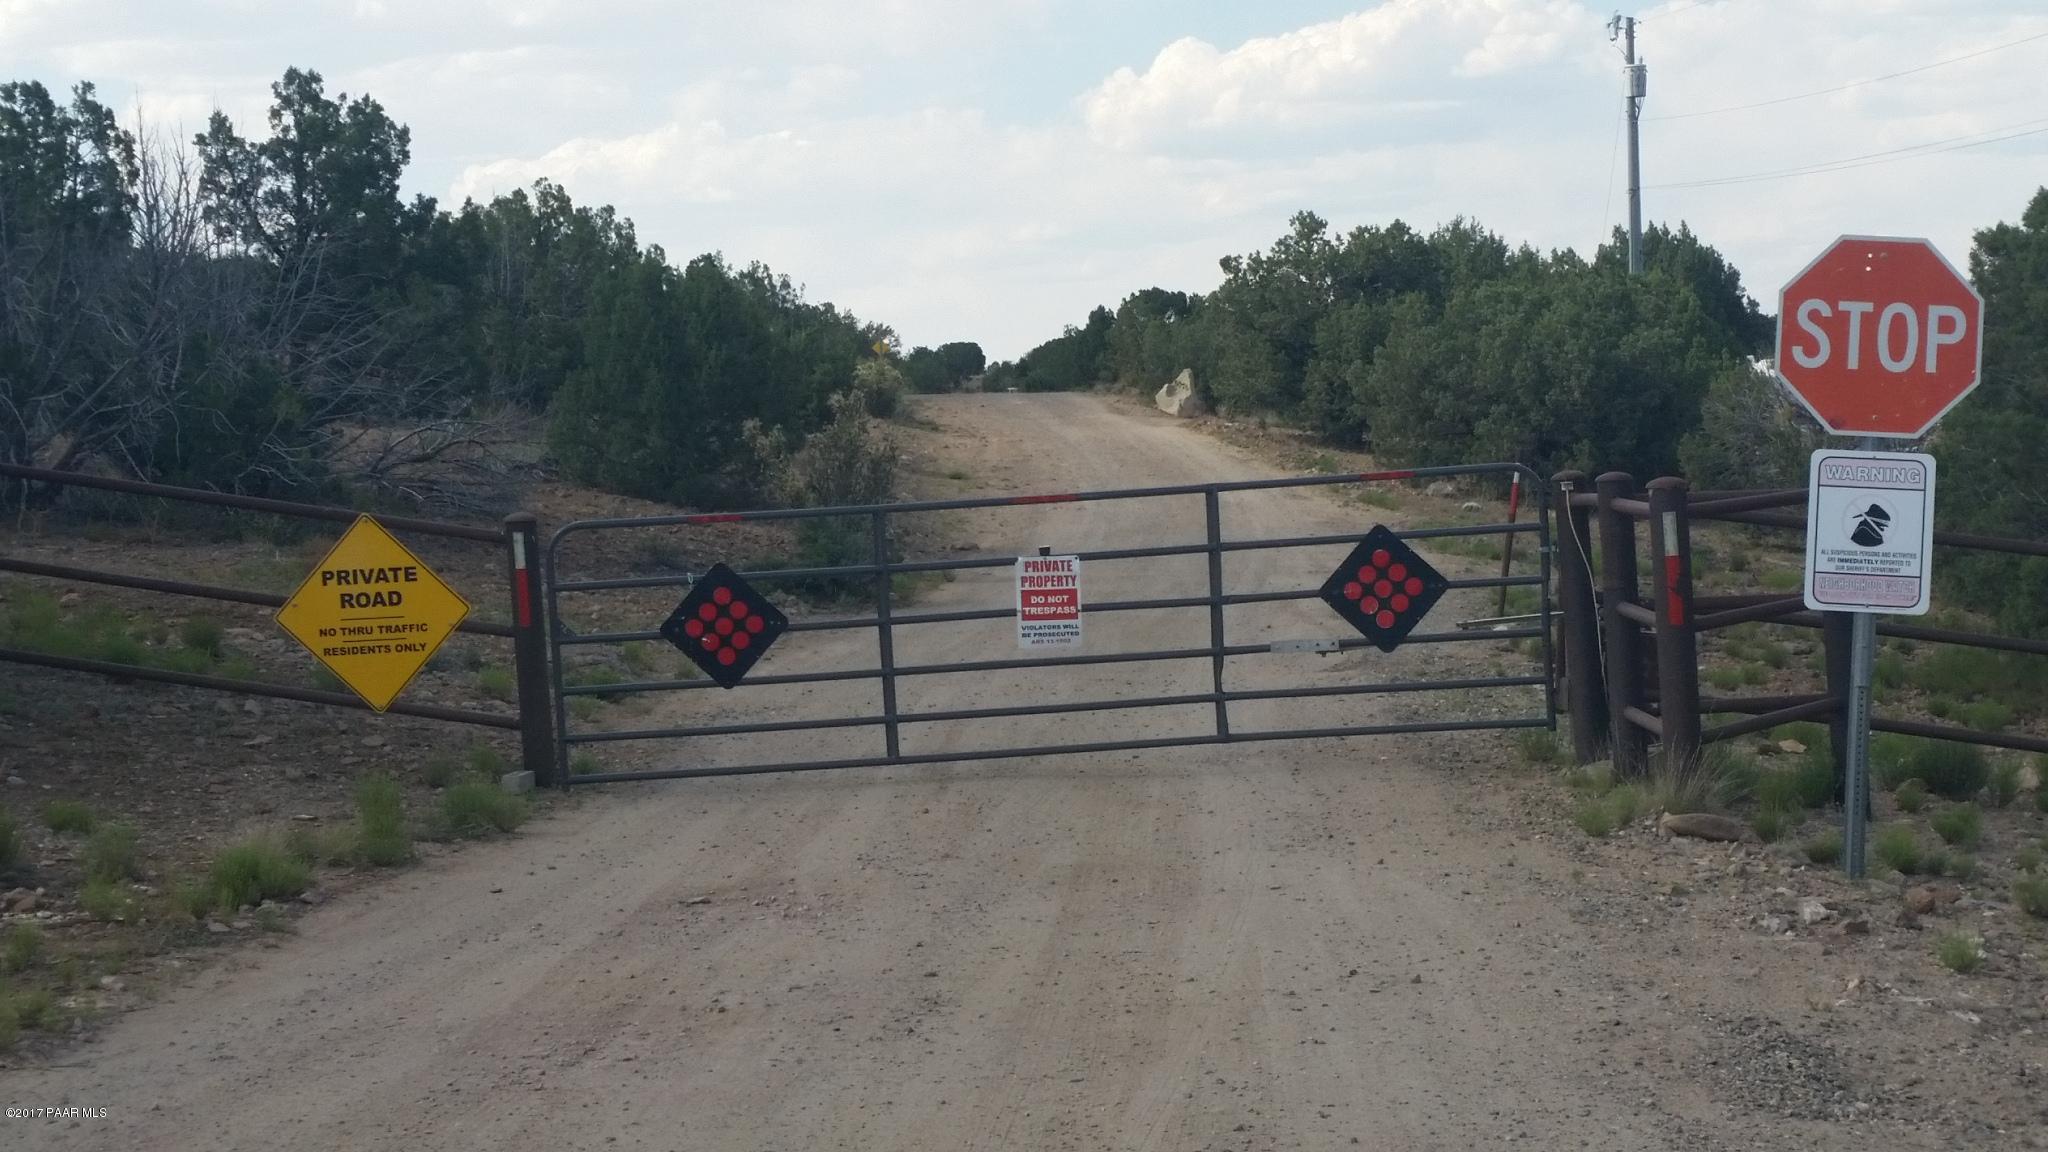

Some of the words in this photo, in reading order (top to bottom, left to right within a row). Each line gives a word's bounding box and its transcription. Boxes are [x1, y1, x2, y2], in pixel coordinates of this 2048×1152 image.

[1791, 298, 1967, 374] STOP
[1825, 464, 1921, 484] WARNING
[1830, 549, 1858, 557] SUSPICIOUS
[1859, 550, 1880, 558] PERSONS
[1024, 560, 1073, 573] PRIVATE
[1837, 557, 1880, 565] IMMEDIATELY
[1880, 559, 1904, 567] REPORTED
[321, 566, 418, 587] PRIVATE
[1870, 566, 1901, 574] DEPARTMENT
[1020, 574, 1077, 588] PROPERTY
[1819, 577, 1883, 592] NEIGHBORHOOD
[339, 590, 403, 609] ROAD
[1030, 595, 1045, 604] DO
[1047, 595, 1069, 603] NOT
[1022, 606, 1077, 616] TRESPASS
[319, 627, 337, 637] NO
[340, 625, 374, 636] THRU
[376, 623, 428, 634] TRAFFIC
[323, 645, 391, 656] RESIDENTS
[395, 643, 428, 652] ONLY
